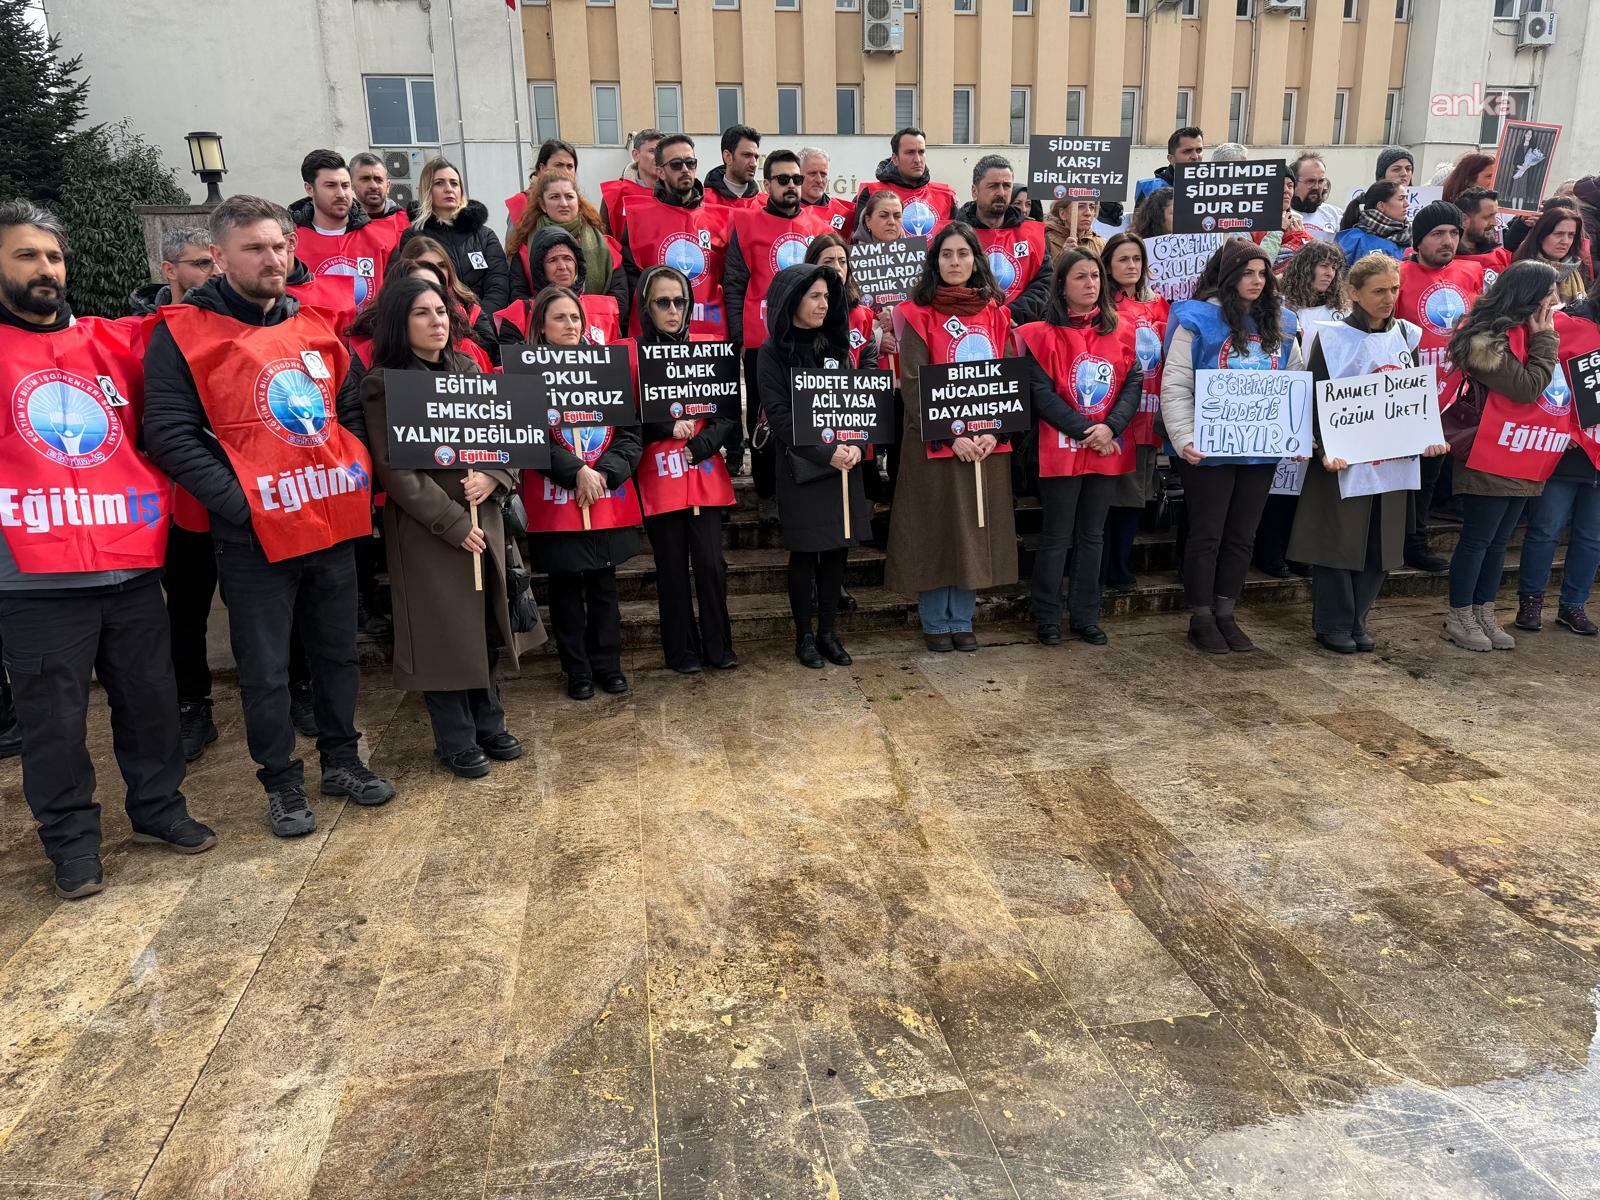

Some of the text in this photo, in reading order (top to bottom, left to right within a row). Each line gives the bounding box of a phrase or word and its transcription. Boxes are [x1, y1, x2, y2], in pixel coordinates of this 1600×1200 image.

[1048, 137, 1111, 152] ŞİDDETE
[1056, 155, 1101, 169] KARŞI
[1184, 162, 1278, 179] EĞİTİMDE
[1033, 170, 1123, 185] BİRLİKTEYİZ
[1185, 181, 1269, 198] ŞİDDETE
[1193, 200, 1264, 215] DUR DE
[896, 250, 926, 264] VAR
[521, 347, 611, 364] GÜVENLİ
[642, 343, 735, 360] YETER ARTIK
[665, 362, 716, 379] ÖLMEK
[947, 362, 1002, 381] BİRLİK
[435, 374, 497, 395] EĞİTİM
[795, 371, 891, 391] ŞİDDETE KARŞI
[644, 381, 738, 401] İSTEMİYORUZ
[812, 390, 876, 408] ACİL YASA
[931, 381, 1019, 402] MÜCADELE
[1325, 382, 1379, 402] RAHMET
[426, 400, 513, 420] EMEKCİSİ
[812, 410, 877, 427] İSTİYORUZ
[928, 399, 1024, 421] DAYANIŞMA
[1201, 397, 1281, 424] ŞİDDETE
[1329, 405, 1374, 428] GÖZÜM
[392, 426, 461, 443] YALNIZ
[464, 424, 545, 444] DEĞİLDİR
